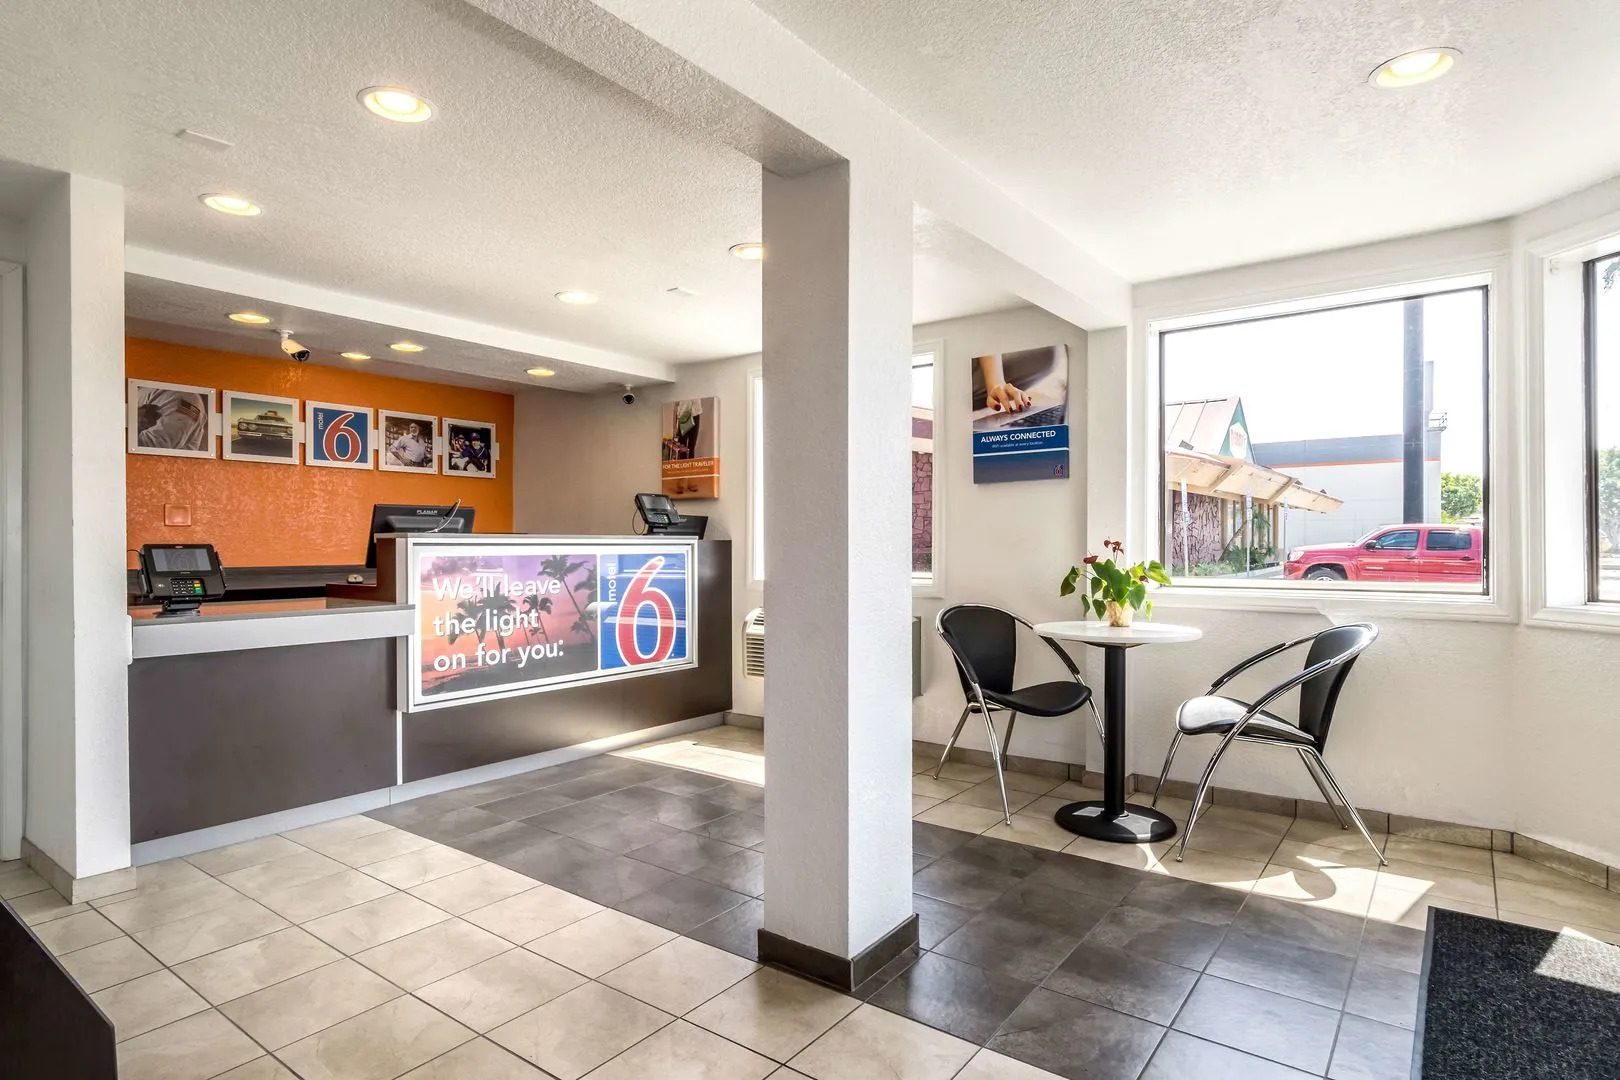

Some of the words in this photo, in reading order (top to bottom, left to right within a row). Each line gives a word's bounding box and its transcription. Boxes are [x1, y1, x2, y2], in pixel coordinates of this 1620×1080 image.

[323, 412, 362, 463] 6
[981, 435, 1008, 443] ALWAYS
[1010, 430, 1056, 440] CONNECTED
[432, 573, 495, 601] We'll
[503, 573, 561, 597] leave
[607, 562, 617, 602] motel
[432, 610, 476, 637] the
[485, 607, 539, 637] light
[616, 555, 677, 667] 6
[433, 652, 466, 672] on
[475, 642, 511, 667] for
